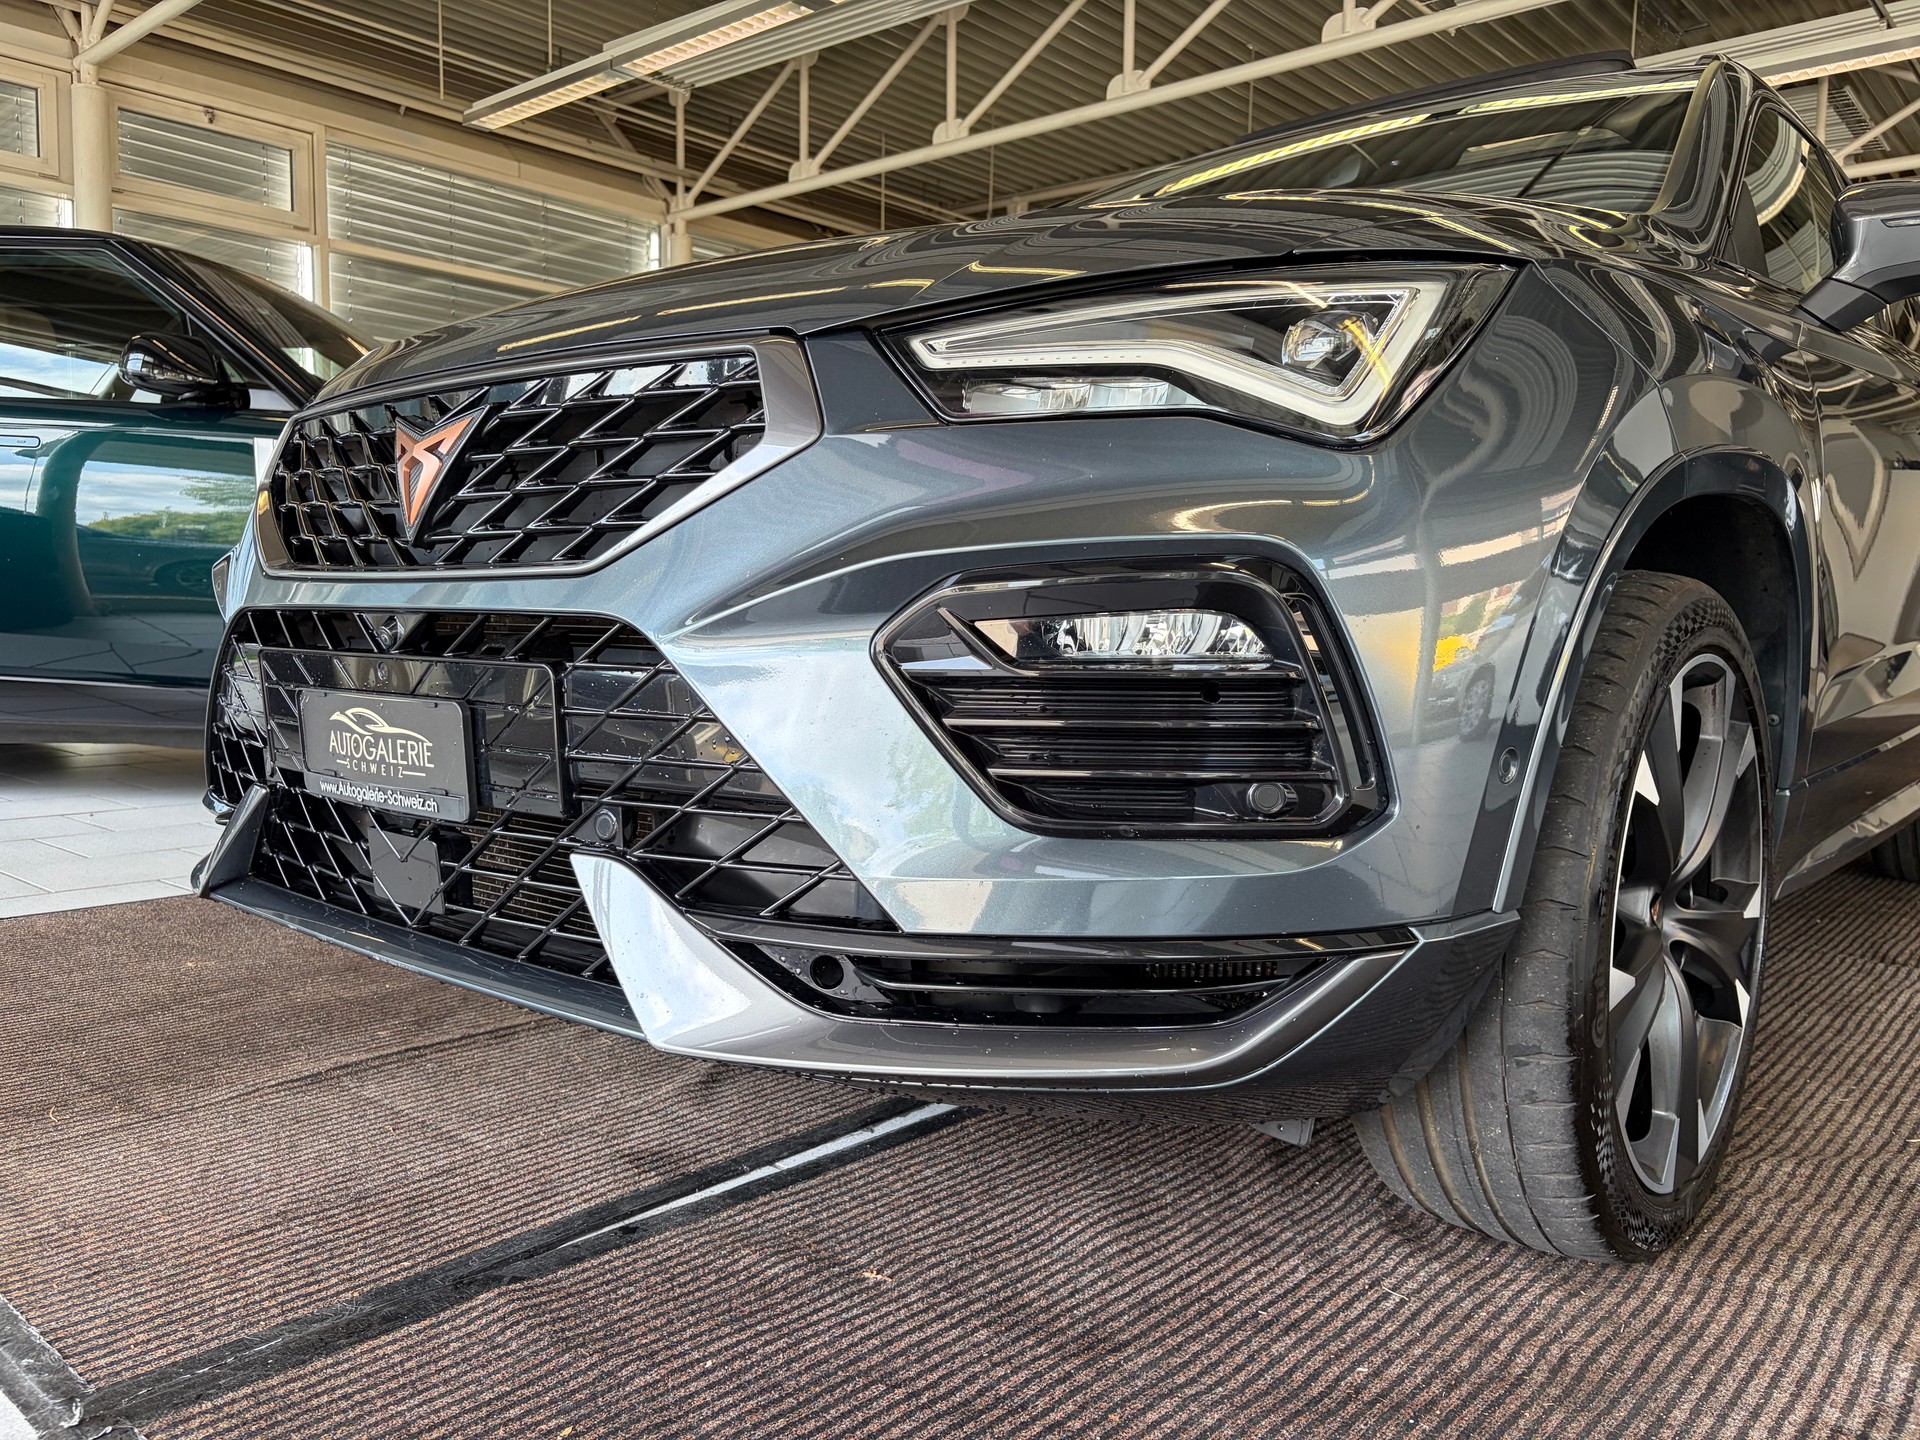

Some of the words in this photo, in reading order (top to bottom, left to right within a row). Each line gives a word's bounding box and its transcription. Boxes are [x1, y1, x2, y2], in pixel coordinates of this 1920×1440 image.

[329, 730, 435, 768] AUTOGALERIE
[346, 758, 404, 778] SCHWEIZ
[319, 780, 438, 813] www.Autogalerie-Schweiz.ch
